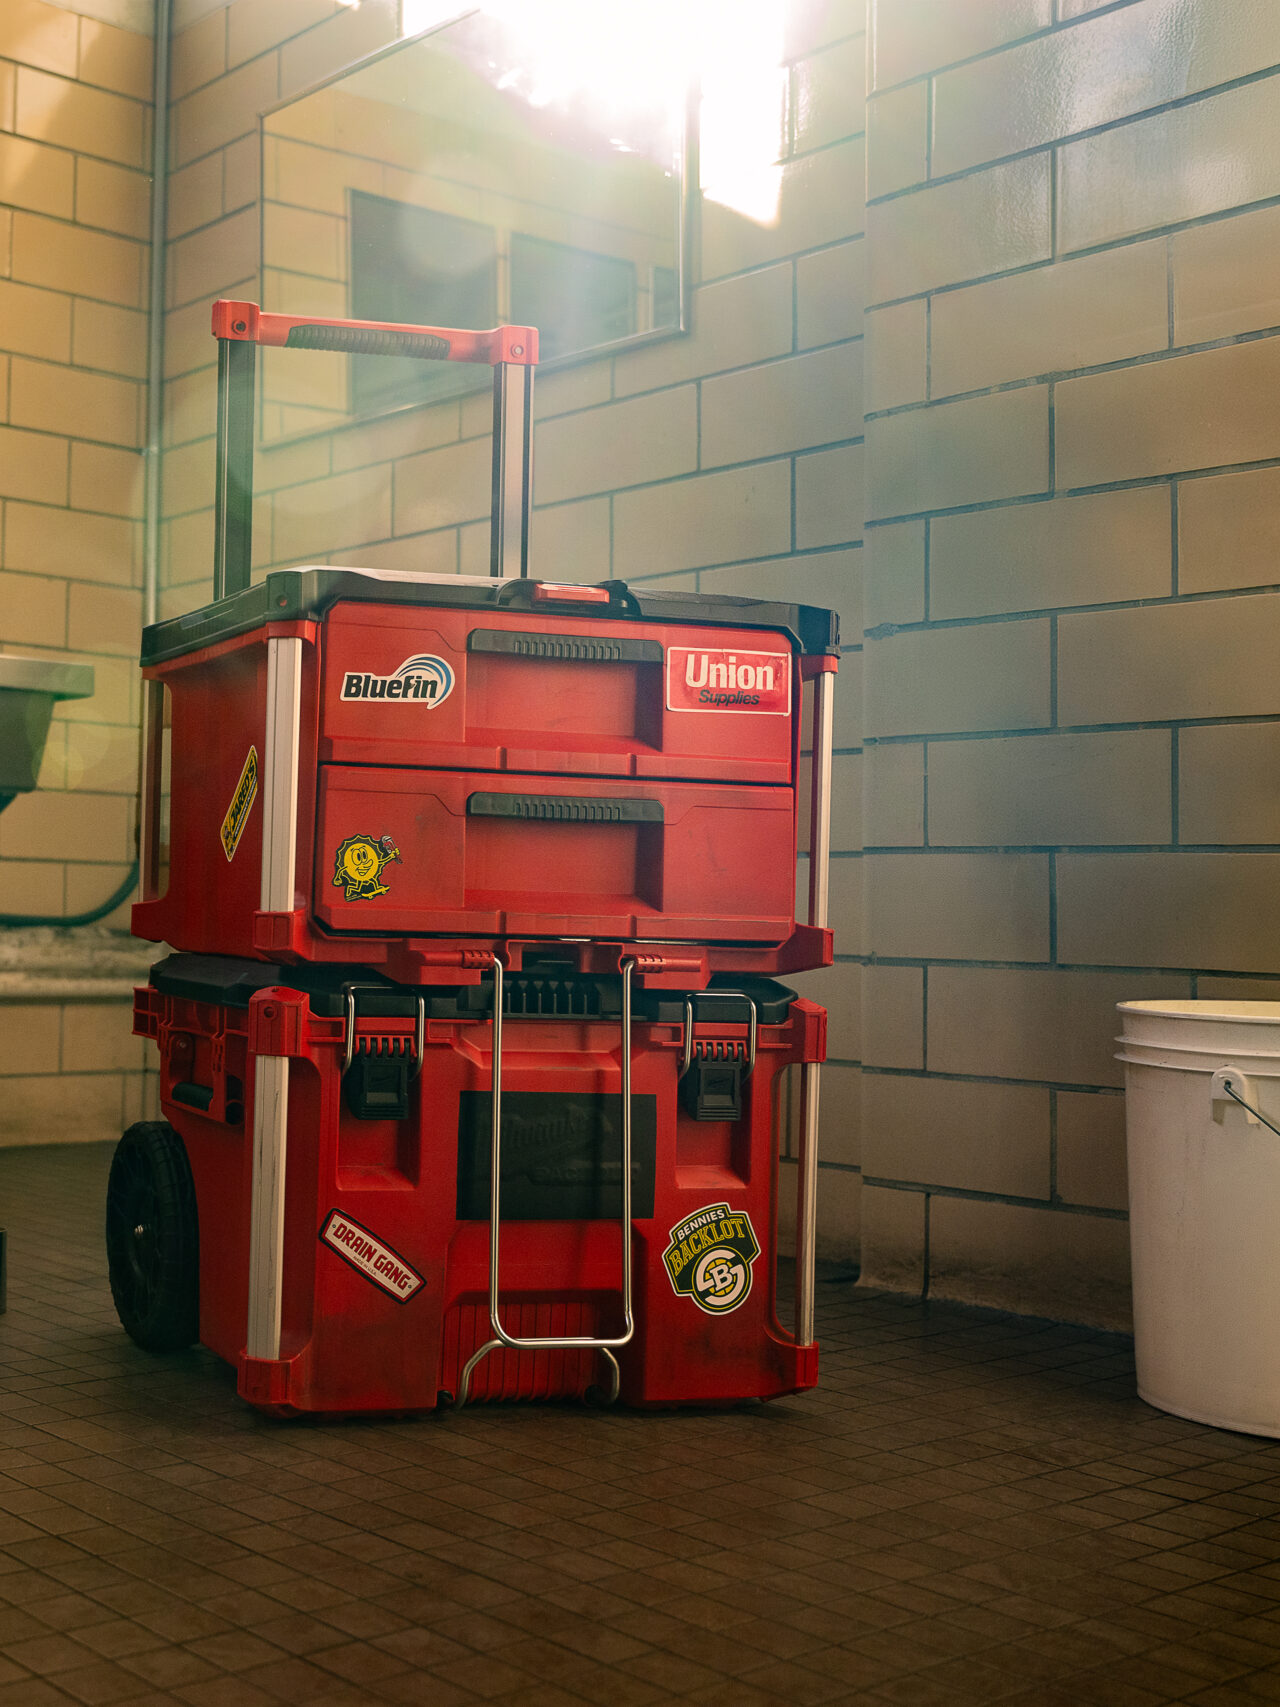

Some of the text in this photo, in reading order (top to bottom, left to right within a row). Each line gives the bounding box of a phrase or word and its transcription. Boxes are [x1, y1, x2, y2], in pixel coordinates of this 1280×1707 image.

[685, 653, 774, 690] Union
[698, 689, 761, 706] Supplies
[677, 1209, 725, 1241] BENNIES
[333, 1222, 412, 1291] DRAIN GANG
[669, 1218, 745, 1277] BACKLOT
